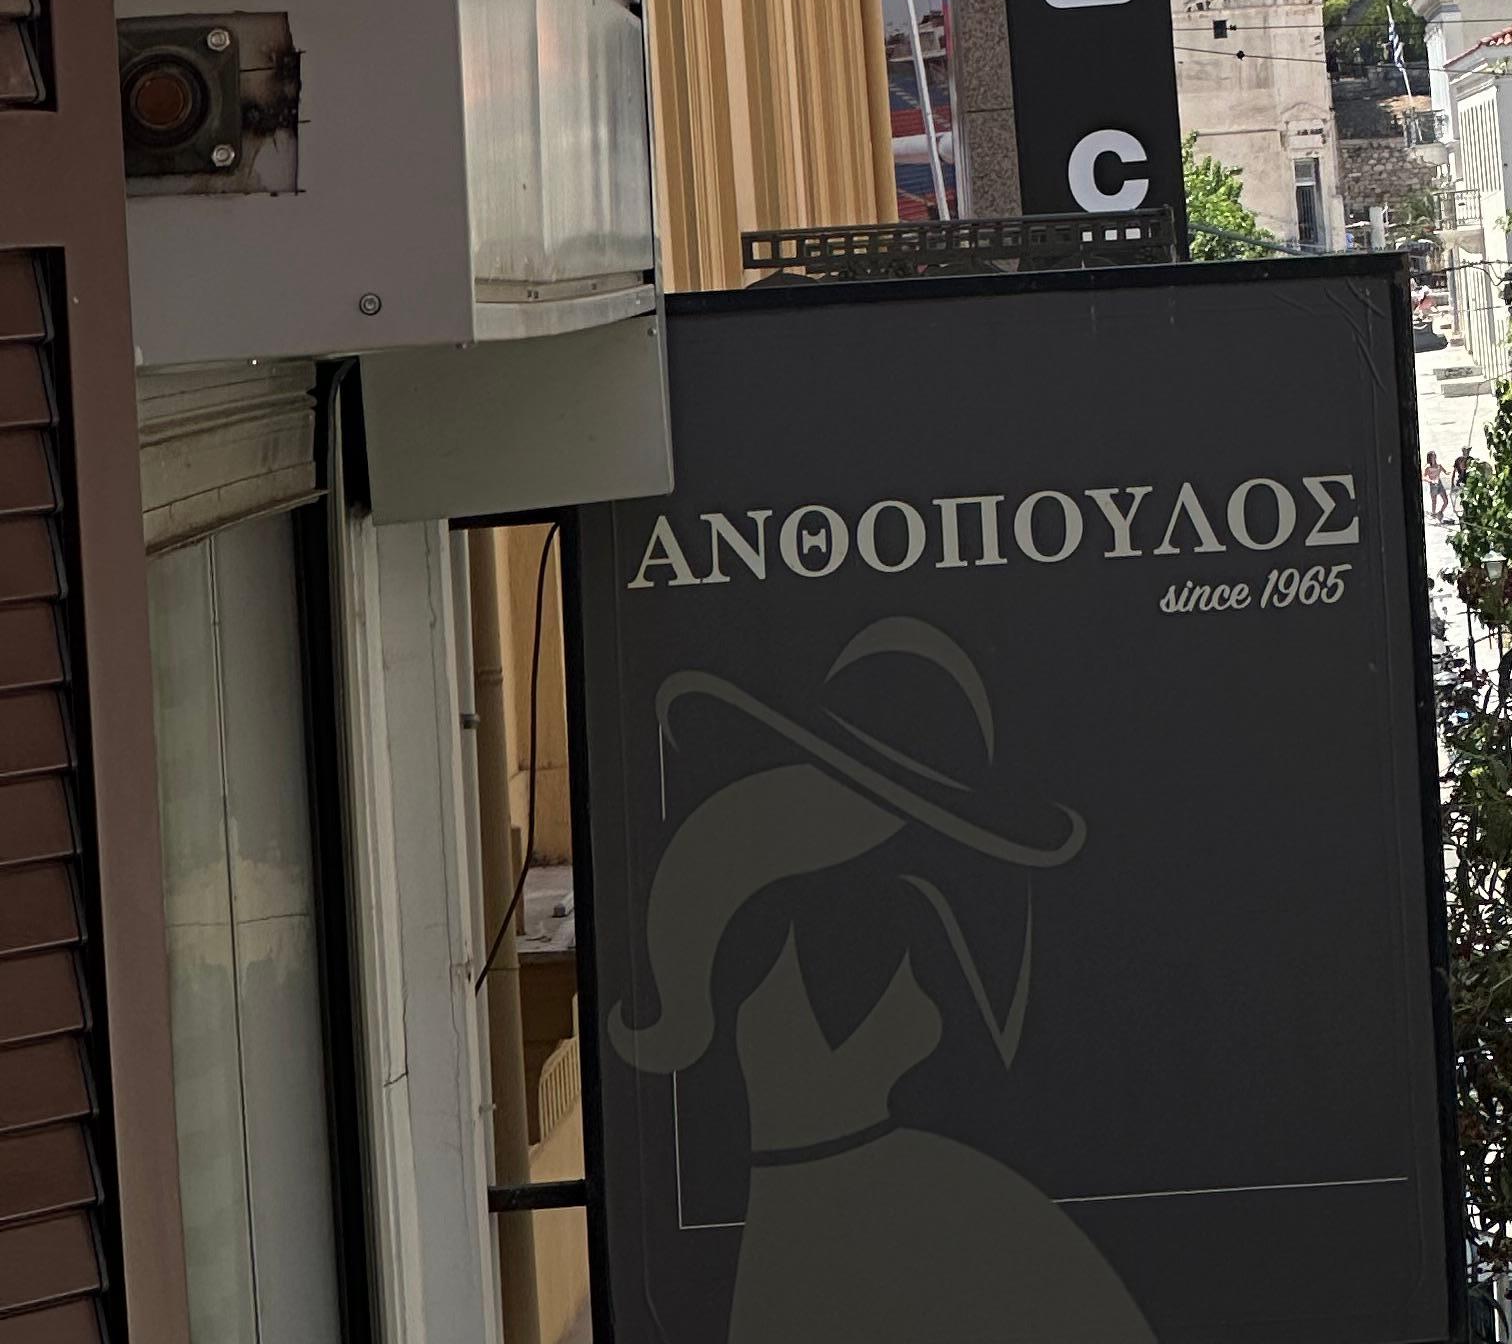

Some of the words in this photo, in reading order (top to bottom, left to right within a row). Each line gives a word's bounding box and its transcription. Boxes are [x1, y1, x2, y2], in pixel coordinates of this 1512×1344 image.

[626, 473, 1361, 589] ΑΝΘΟΠΟΥΛΟΣ
[1159, 574, 1252, 613] since
[1259, 563, 1353, 609] 1965
